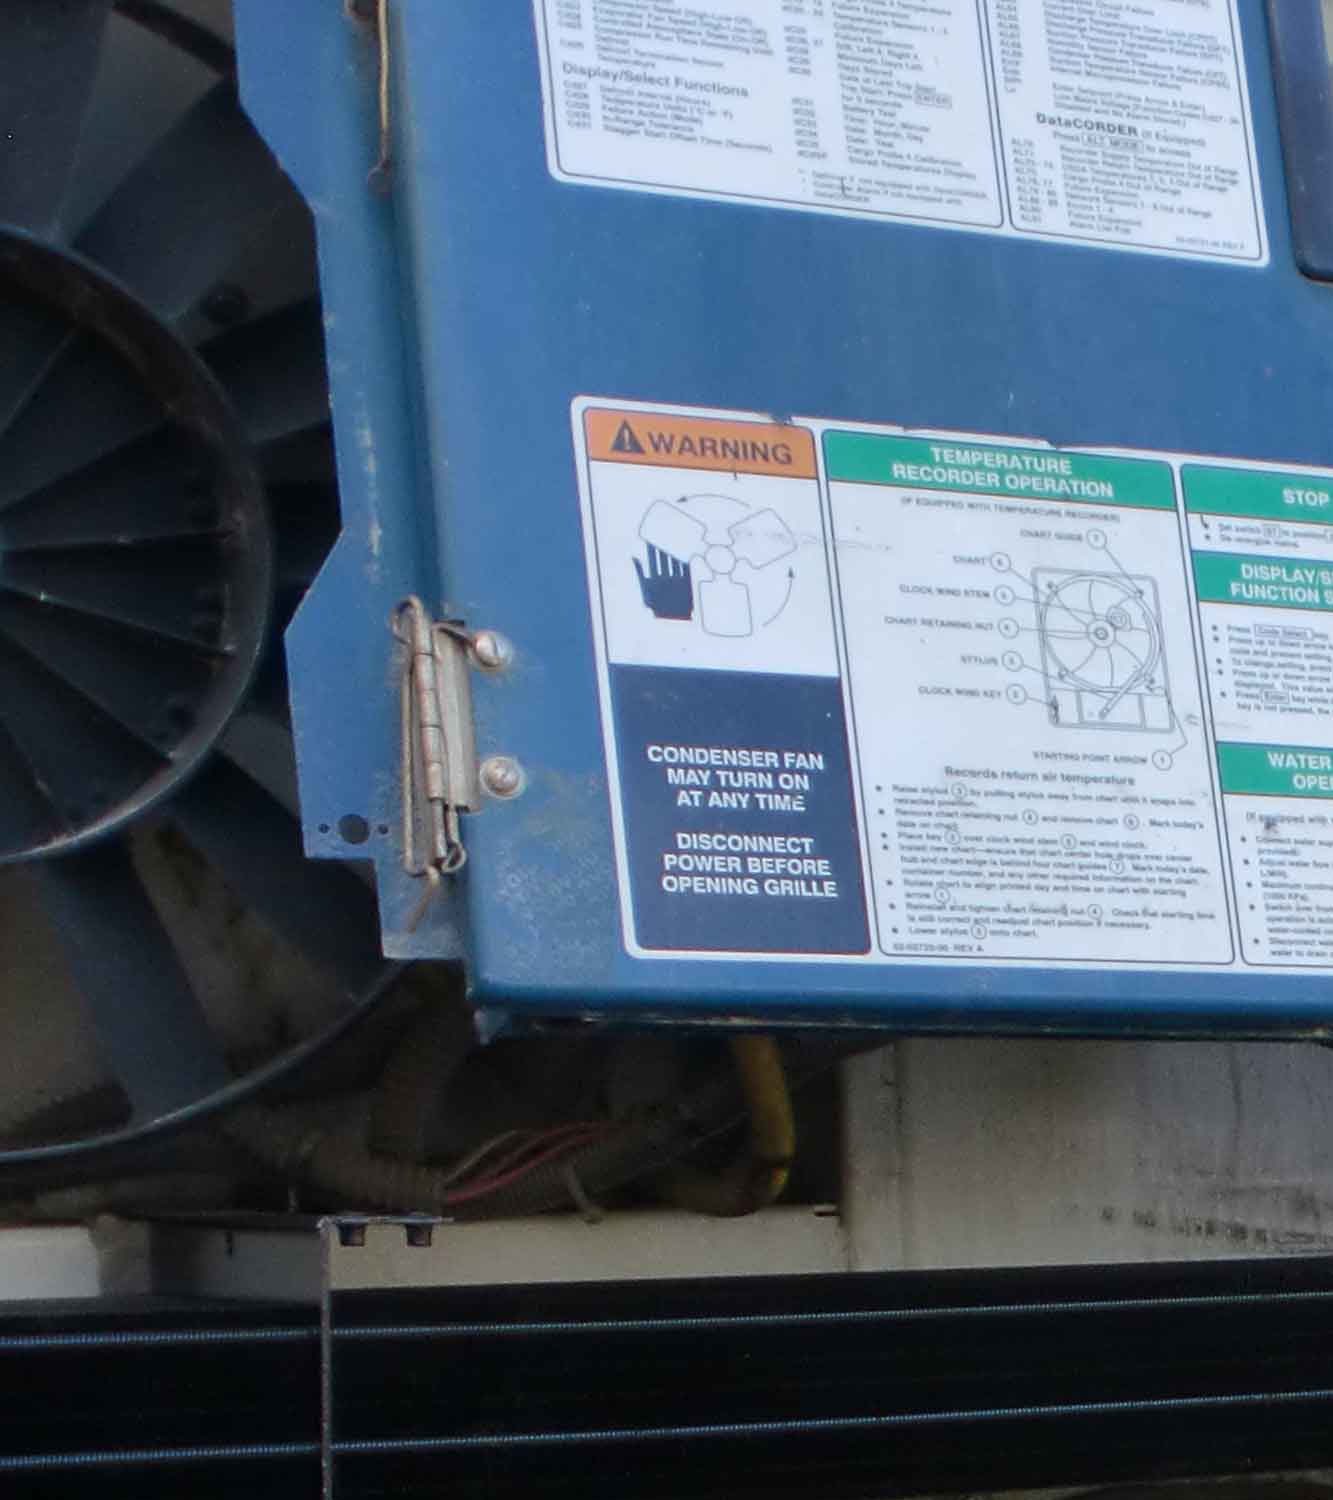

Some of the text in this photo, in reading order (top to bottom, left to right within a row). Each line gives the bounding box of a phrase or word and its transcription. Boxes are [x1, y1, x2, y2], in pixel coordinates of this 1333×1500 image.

[562, 61, 749, 97] Display/Select Functions
[1036, 112, 1139, 136] DataCORDER
[648, 431, 793, 466] WARNING
[930, 447, 1072, 476] TEMPERATURE
[891, 462, 1114, 498] RECORDER OPERATION
[1281, 487, 1331, 508] STOP
[1229, 581, 1321, 605] FUNCTION
[646, 745, 824, 770] CONDENSER FAN
[1266, 752, 1332, 770] WATER
[666, 767, 810, 790] MAY TURN ON
[944, 766, 1136, 788] Records return air temperature
[675, 789, 806, 811] AT ANY TIME
[675, 832, 815, 854] DISCONNECT
[663, 853, 832, 876] POWER BEFORE
[661, 875, 838, 898] OPENING GRILLE
